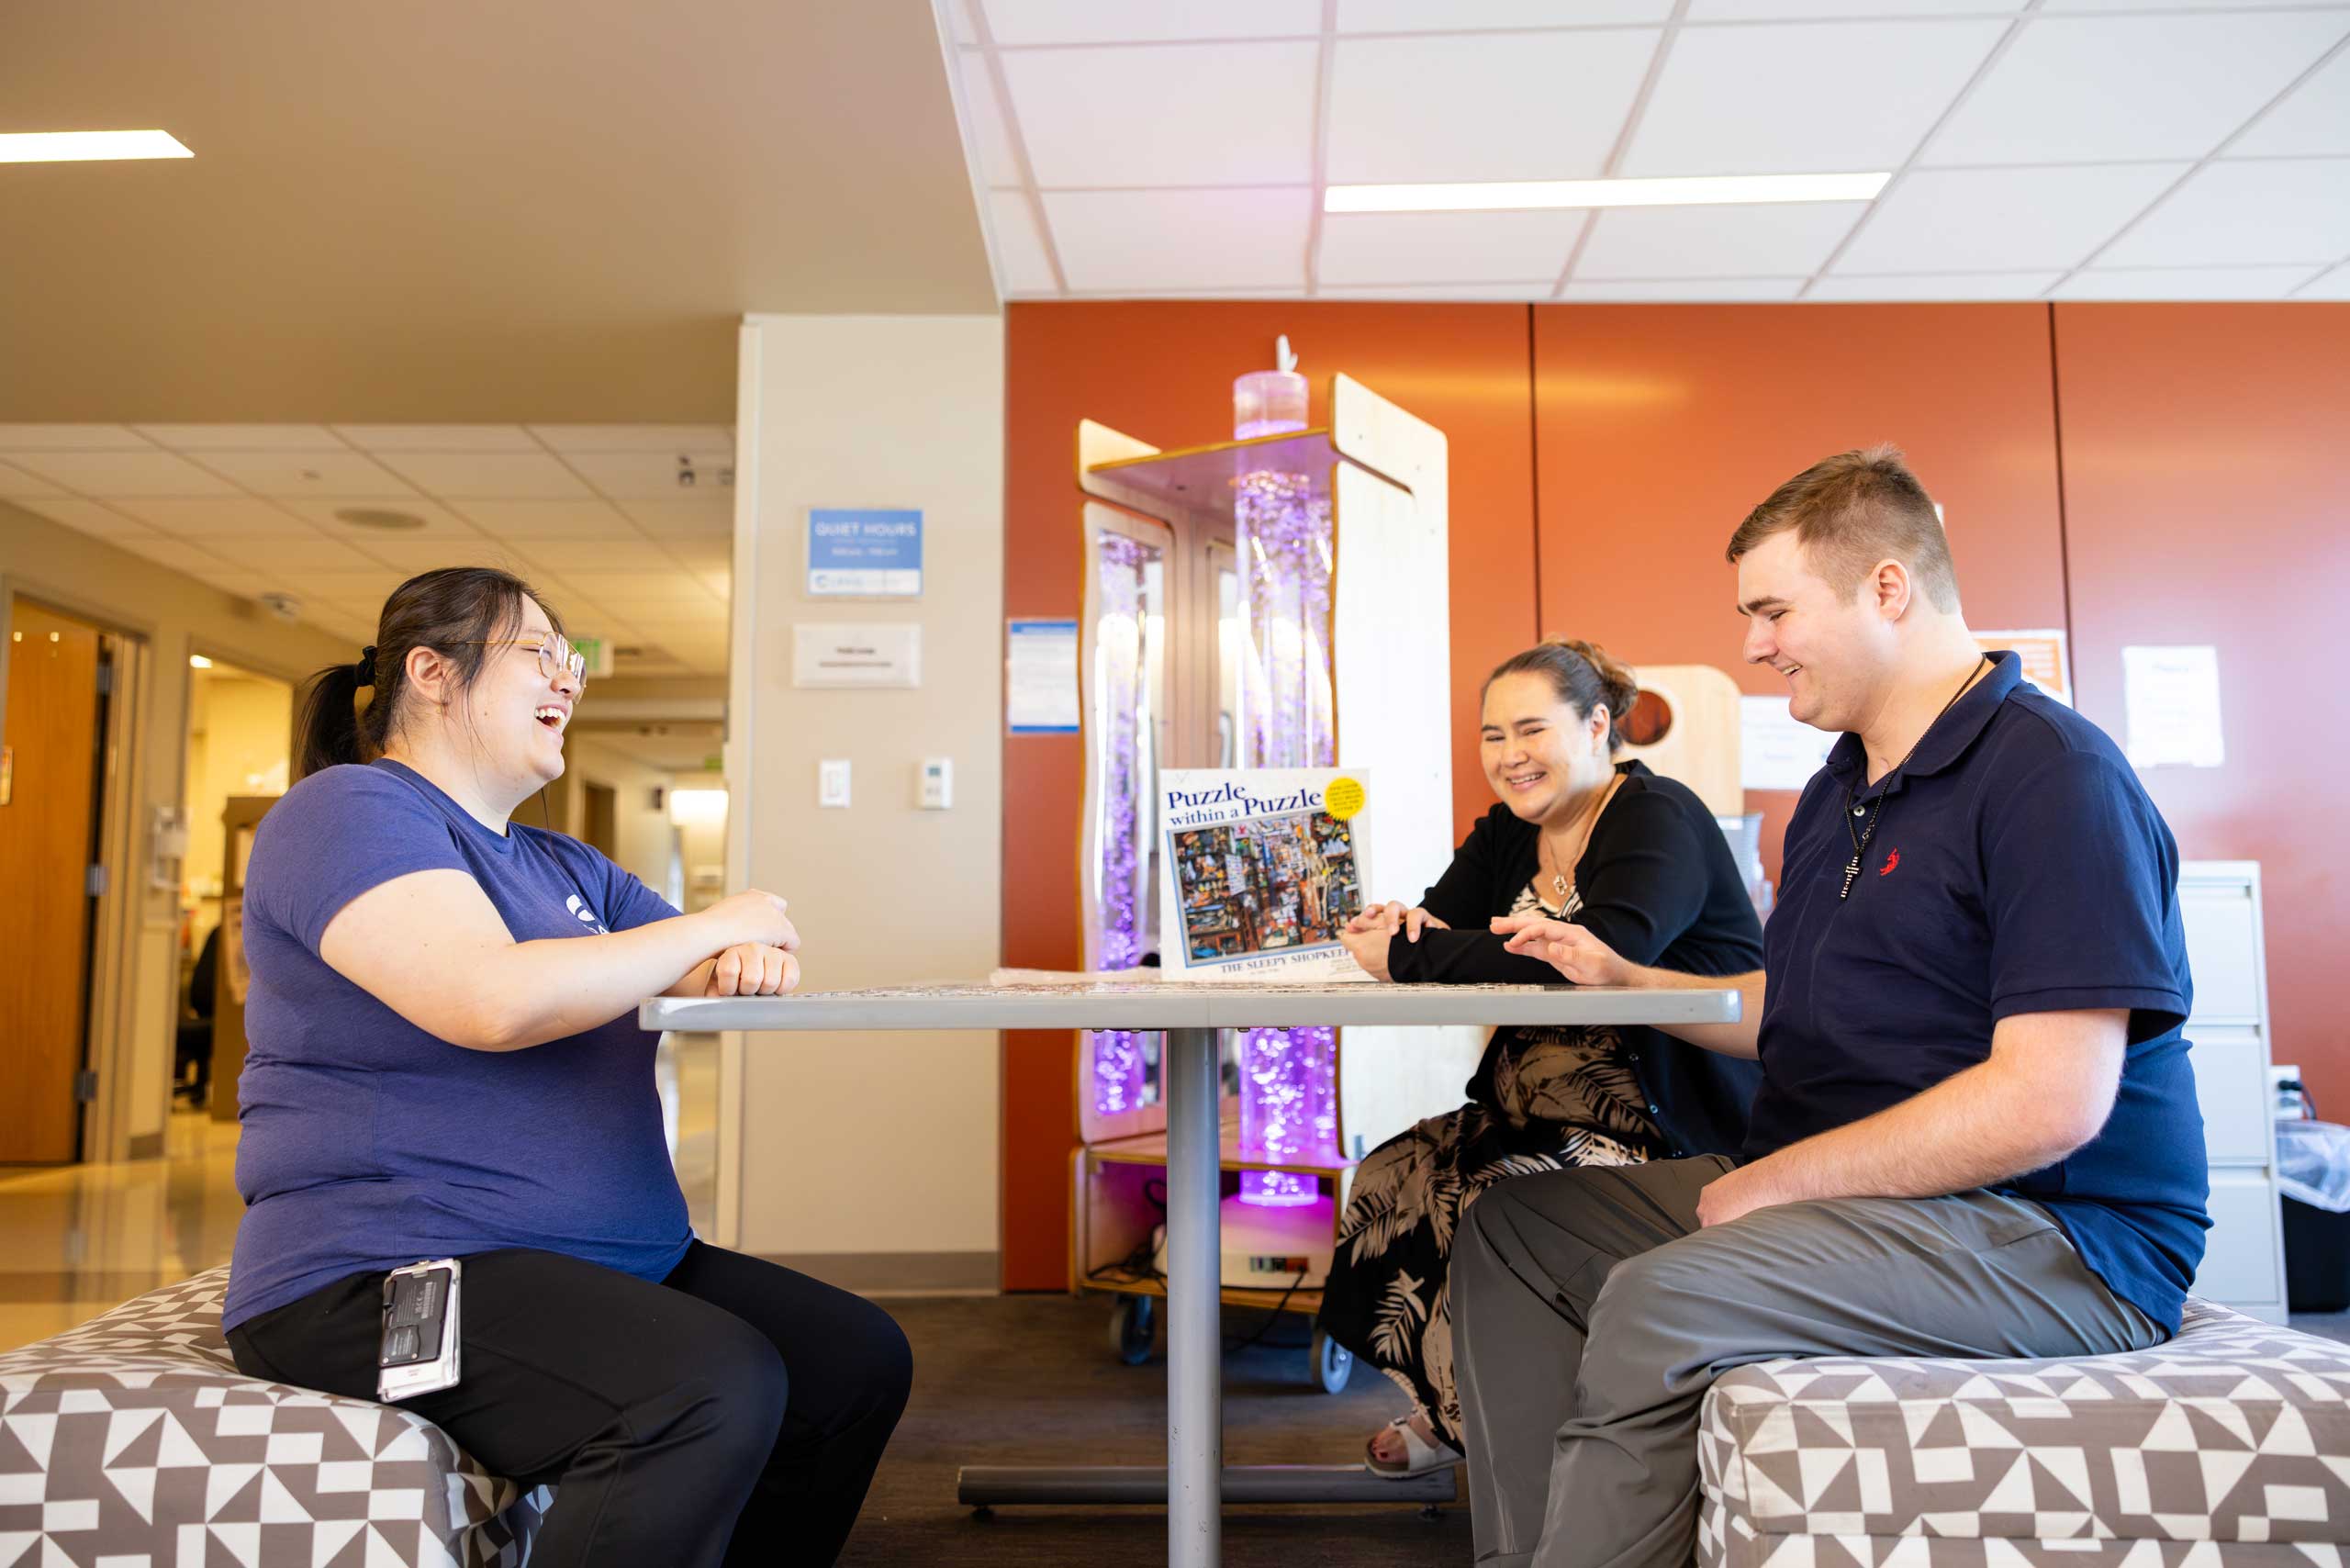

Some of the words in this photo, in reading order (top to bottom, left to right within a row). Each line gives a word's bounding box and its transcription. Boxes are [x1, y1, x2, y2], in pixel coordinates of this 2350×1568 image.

[815, 521, 860, 536] QUIET
[864, 521, 917, 536] HOURS
[1167, 782, 1247, 810] Puzzle
[1169, 809, 1225, 826] within
[1230, 808, 1239, 818] a
[1244, 789, 1322, 816] Puzzle
[1221, 963, 1245, 974] THE
[1247, 958, 1286, 969] SLEEPY
